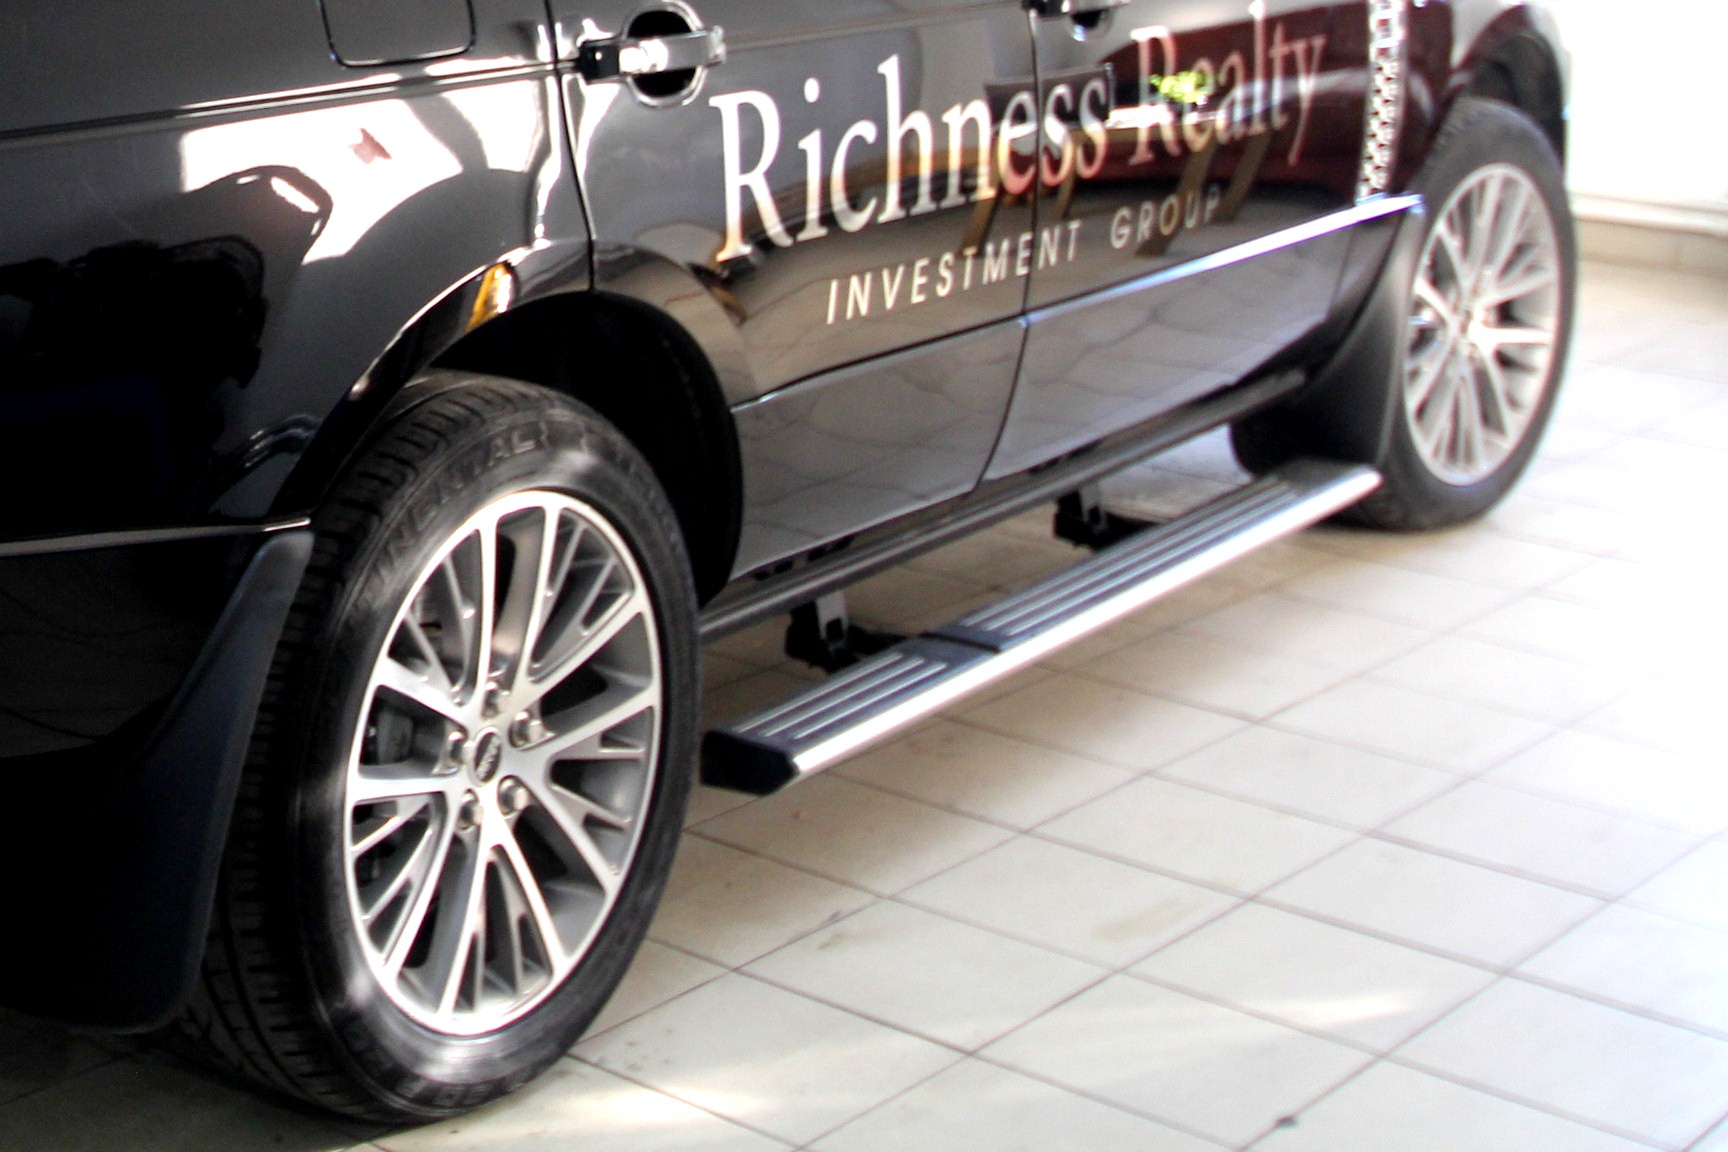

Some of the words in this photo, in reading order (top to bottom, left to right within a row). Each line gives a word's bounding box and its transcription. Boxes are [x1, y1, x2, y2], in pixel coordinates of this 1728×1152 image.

[709, 53, 1110, 262] Richness
[826, 218, 1082, 325] INVESTMENT
[1111, 186, 1222, 250] GROUP
